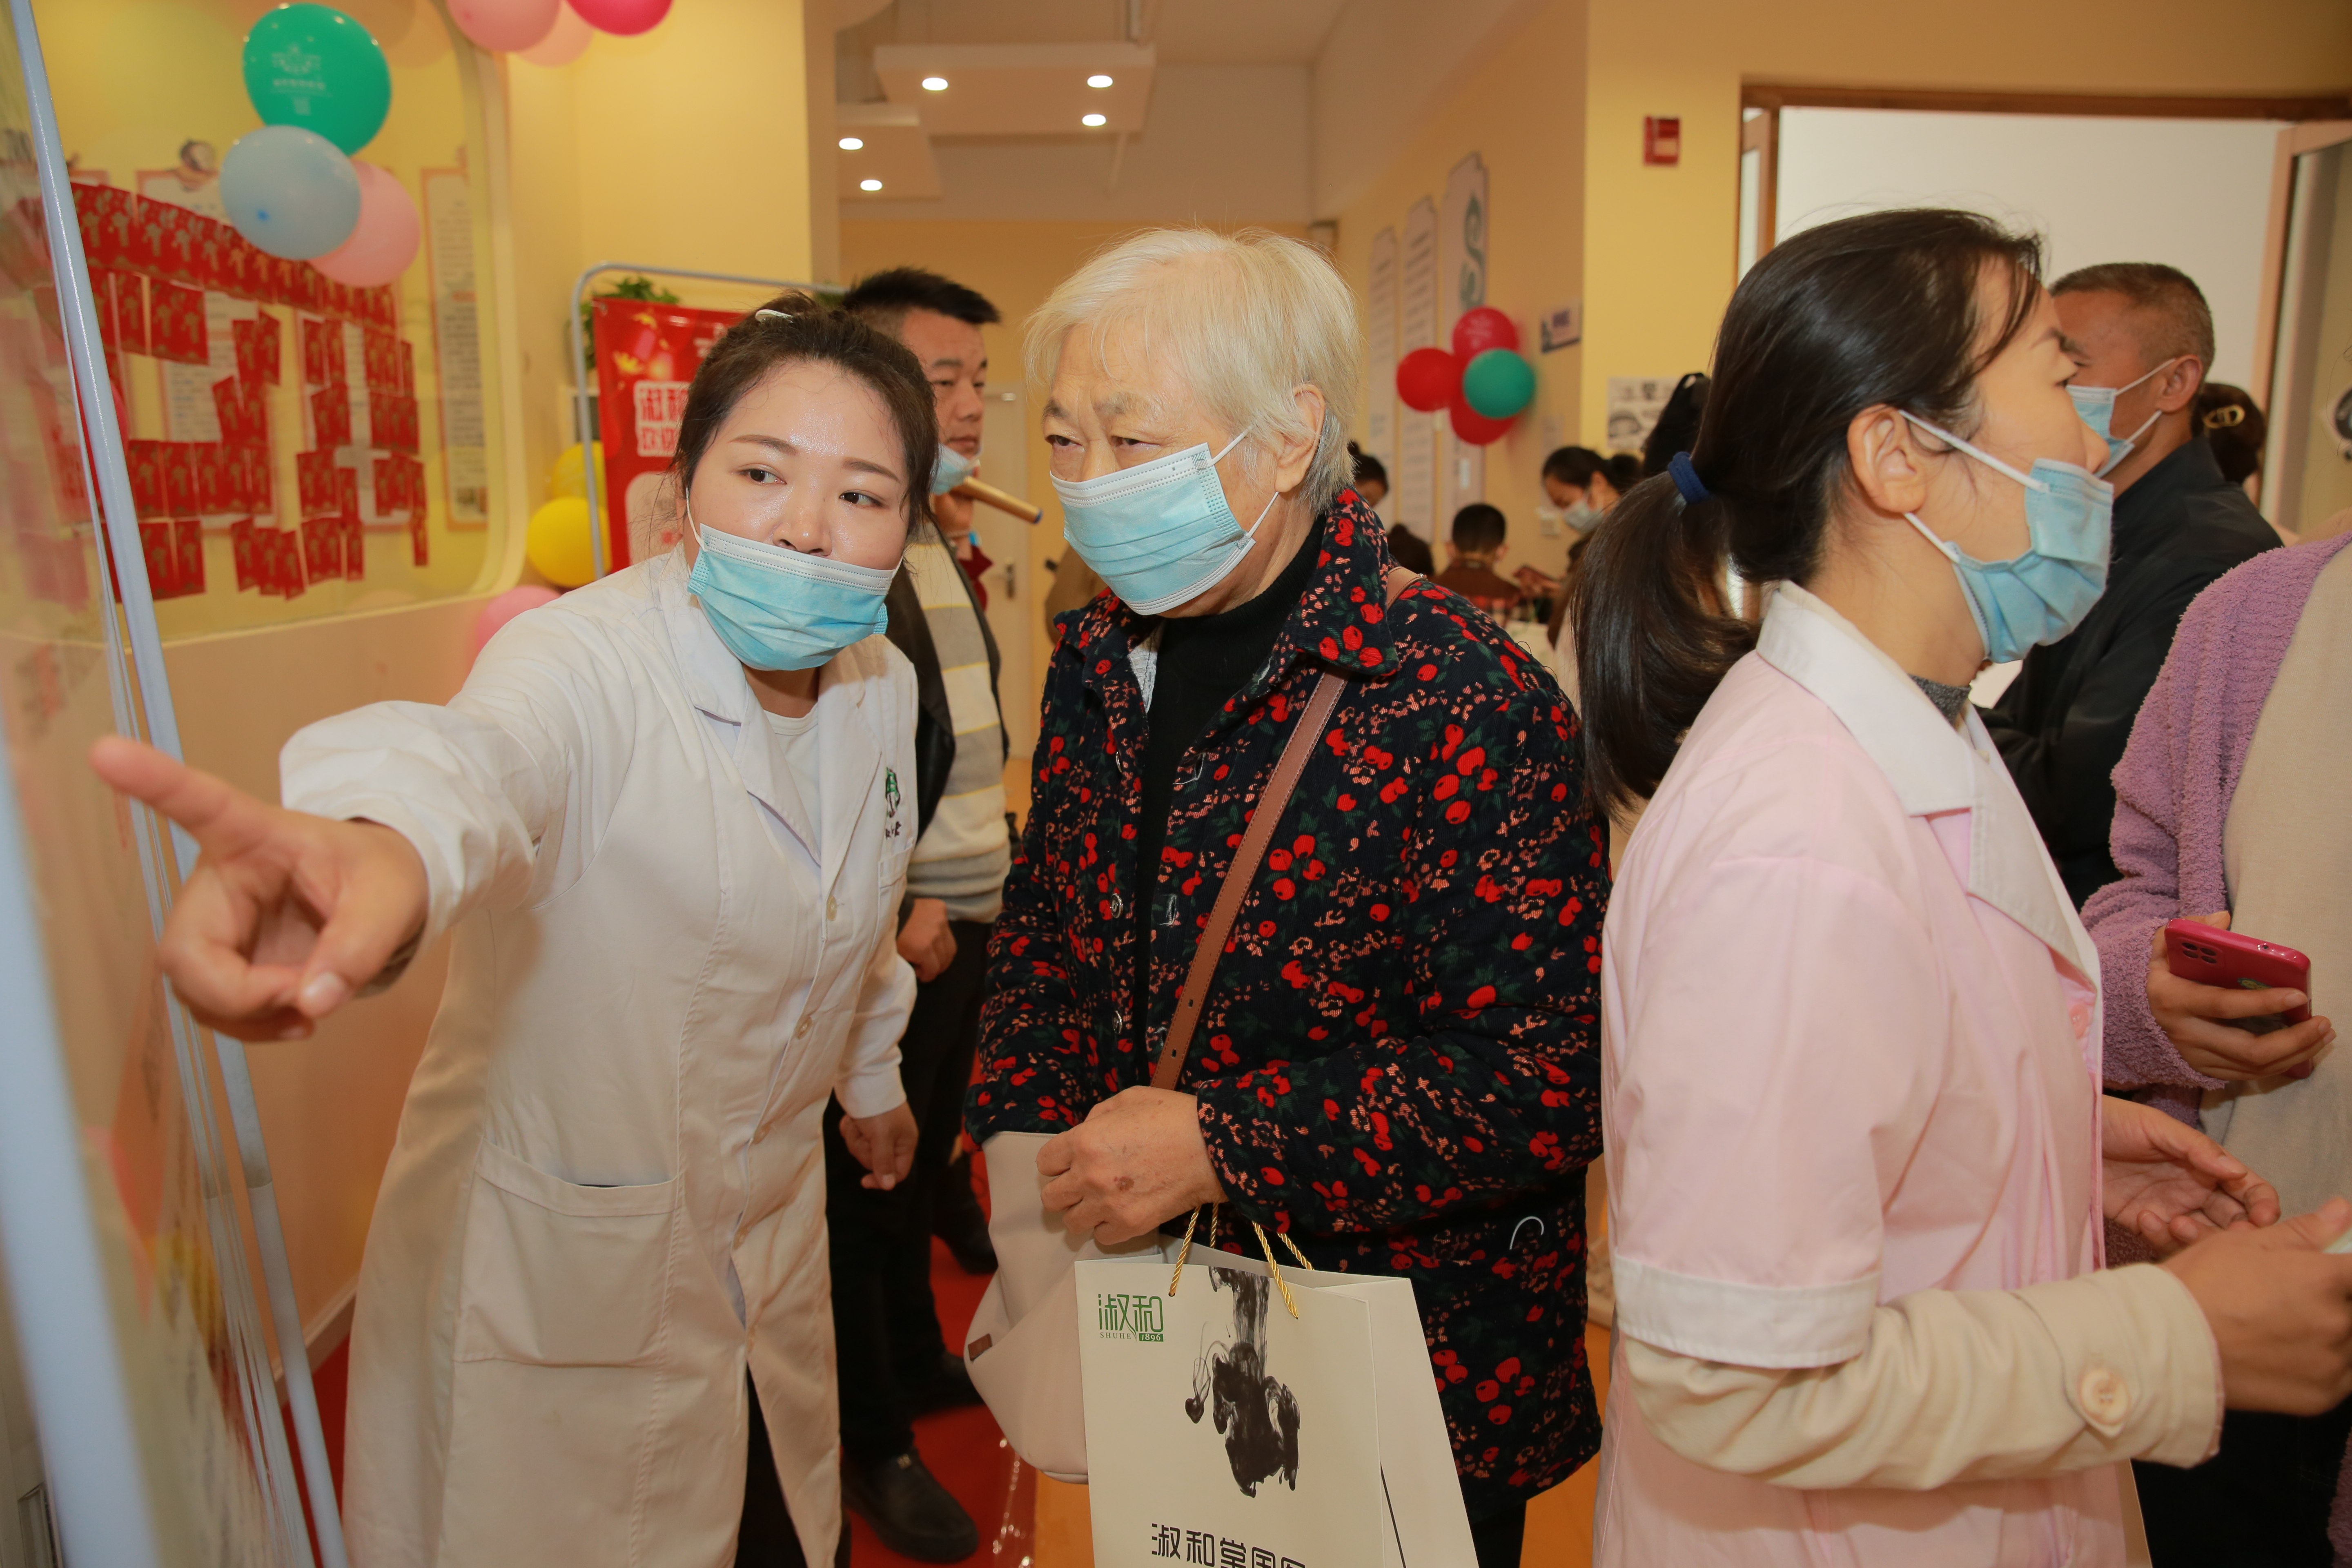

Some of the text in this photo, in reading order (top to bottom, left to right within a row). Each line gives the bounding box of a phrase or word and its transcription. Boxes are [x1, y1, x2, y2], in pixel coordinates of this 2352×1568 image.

[1098, 1294, 1164, 1332] 淑和
[1141, 1333, 1161, 1341] 1896
[1151, 1523, 1305, 1568] 淑和堂国
